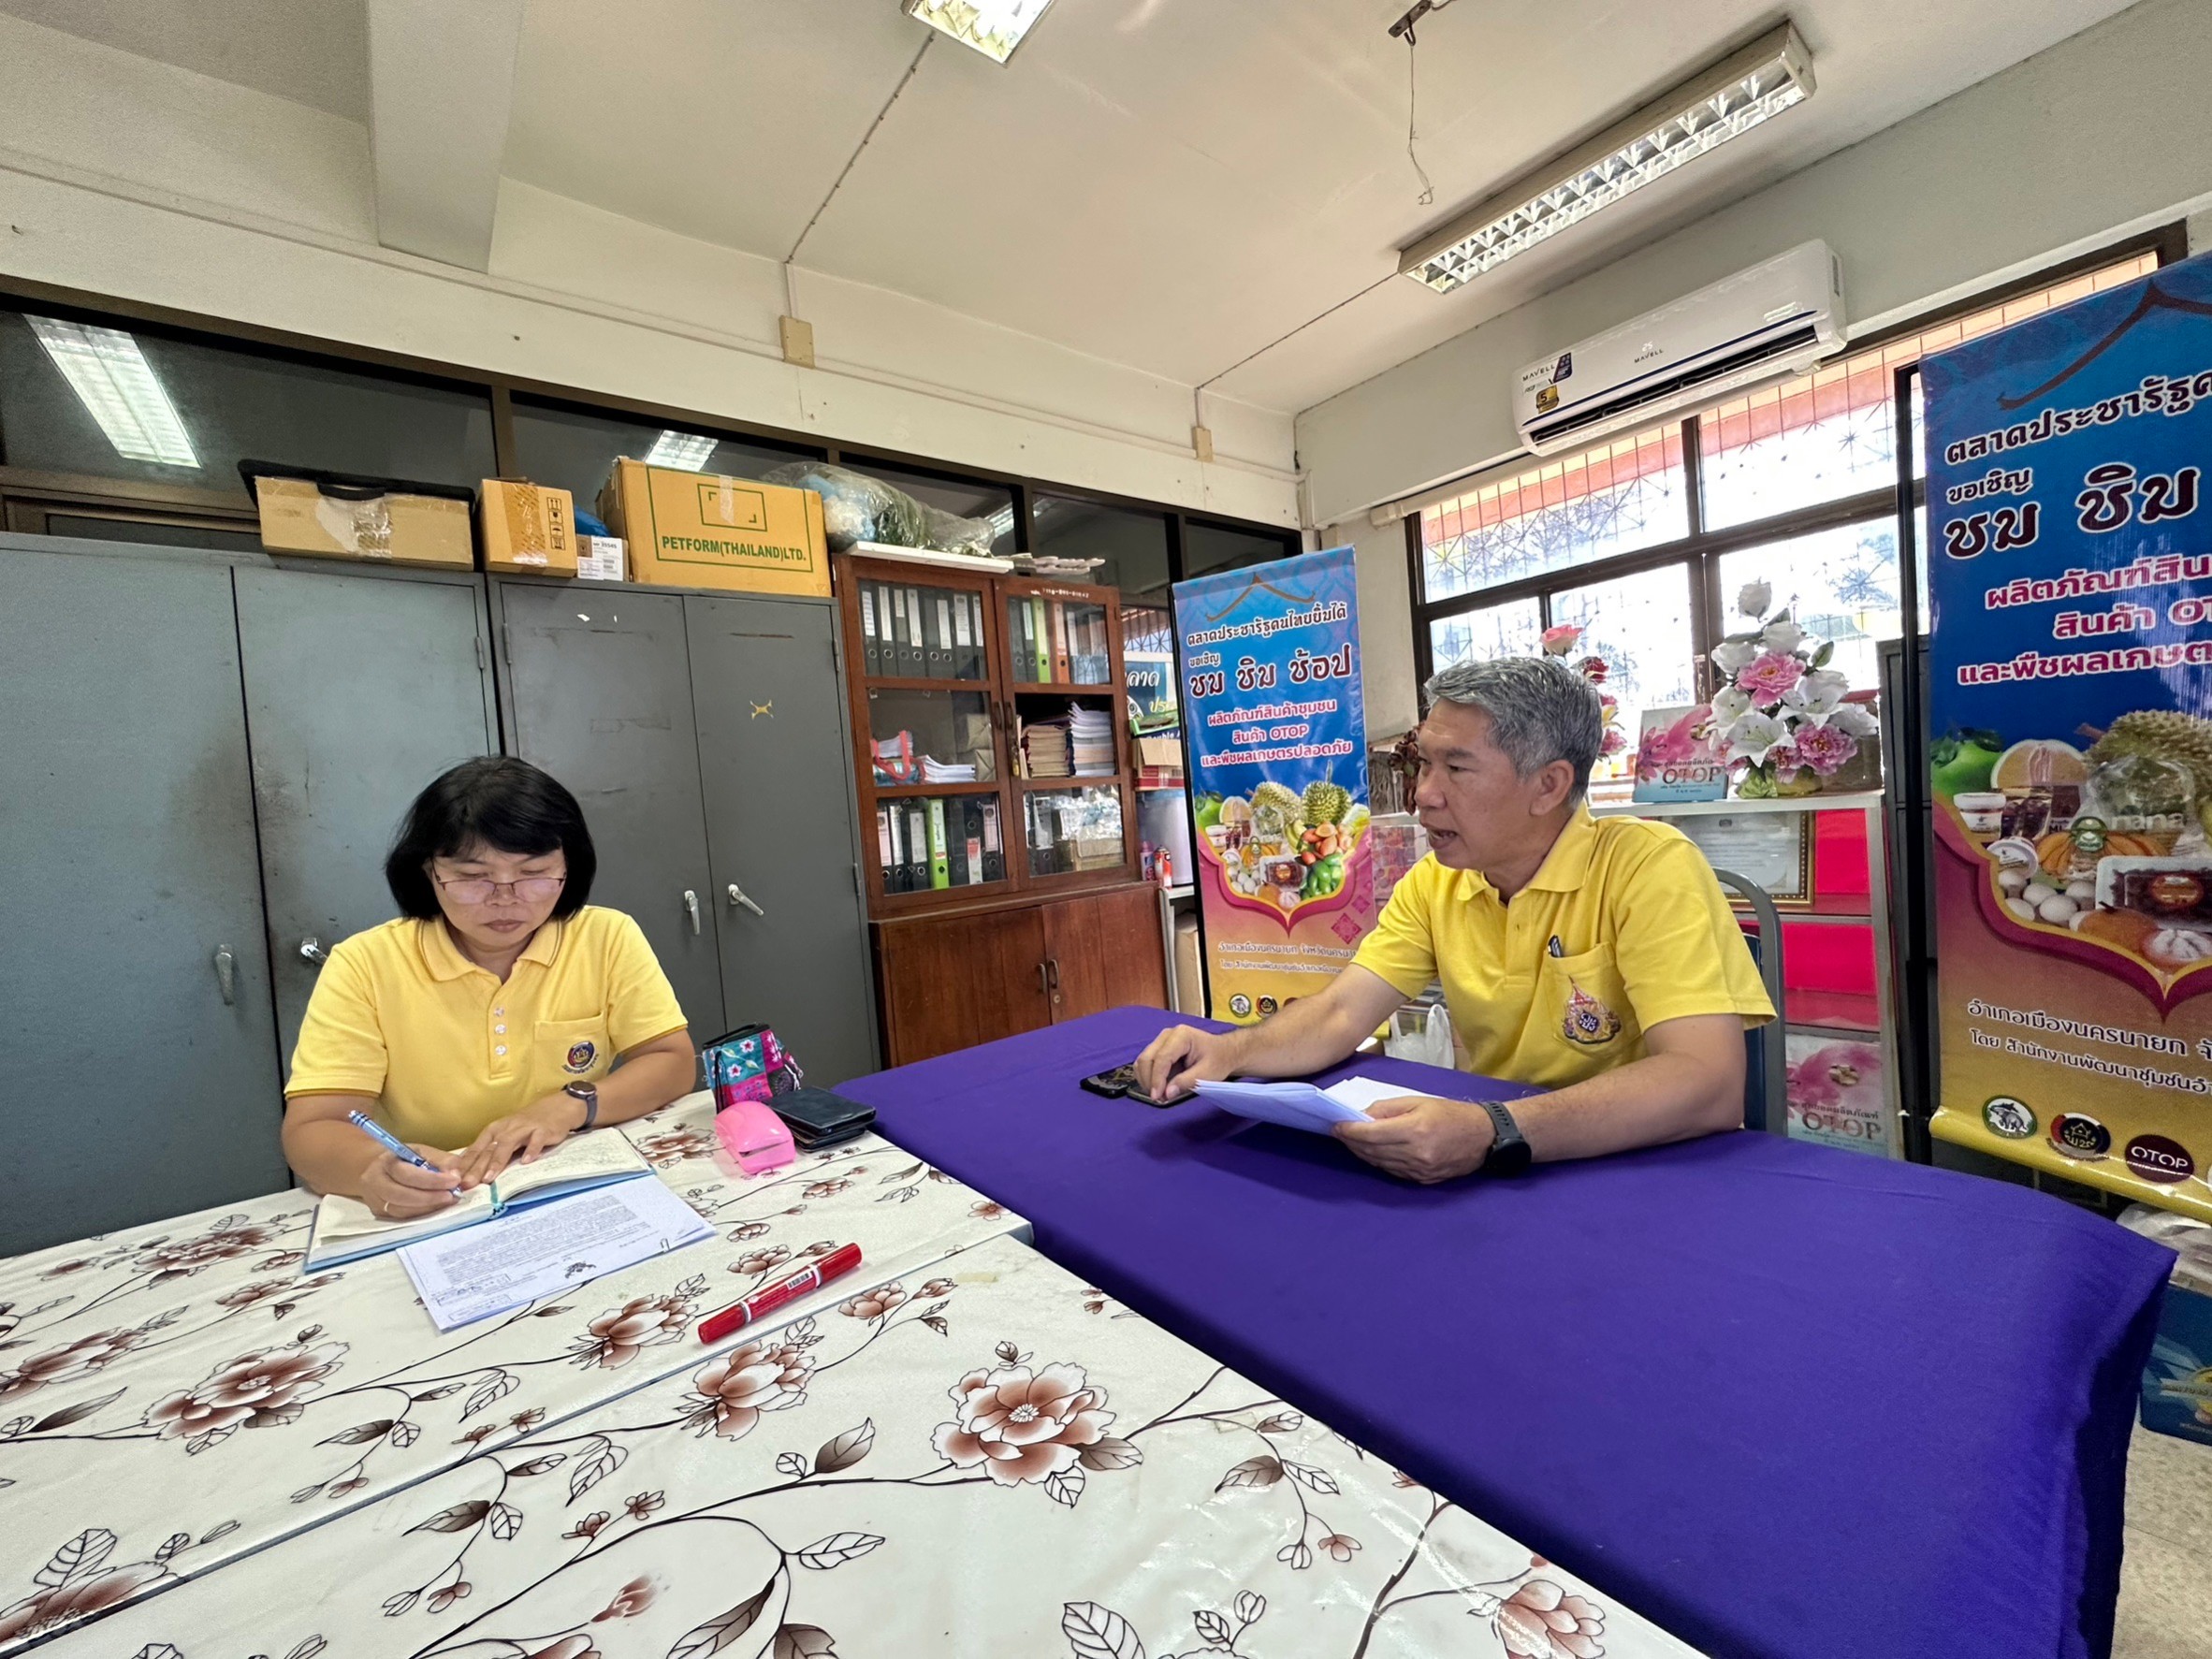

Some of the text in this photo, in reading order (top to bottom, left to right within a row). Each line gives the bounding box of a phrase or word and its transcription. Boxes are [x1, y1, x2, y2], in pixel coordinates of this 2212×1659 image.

[1633, 347, 1664, 363] MAVELL
[1521, 363, 1555, 382] MAVELL
[1947, 468, 2033, 504] ขอเชิญ
[1944, 462, 2201, 559] ชม ชิม
[662, 534, 808, 561] PETFORM(THAILAND)LTD.
[1186, 602, 1347, 648] ตลาดประชารัฐคนไทยยิ้มได้
[2053, 602, 2156, 639] สินค้า
[1188, 651, 1220, 669] ขอเชิญ
[1189, 643, 1353, 699] ชม ชิม ช้อป
[1207, 699, 1338, 727] ผลิตภัณฑ์สินค้าชุมชน
[1231, 724, 1310, 745] สินค้า OTOP
[1201, 738, 1354, 767] และพืชผลเกษตรปลอดภัย
[1662, 765, 1722, 784] OTOP
[1970, 1028, 2001, 1048] โดย
[1801, 1112, 1882, 1140] OTOP
[2131, 1145, 2189, 1169] OTOP
